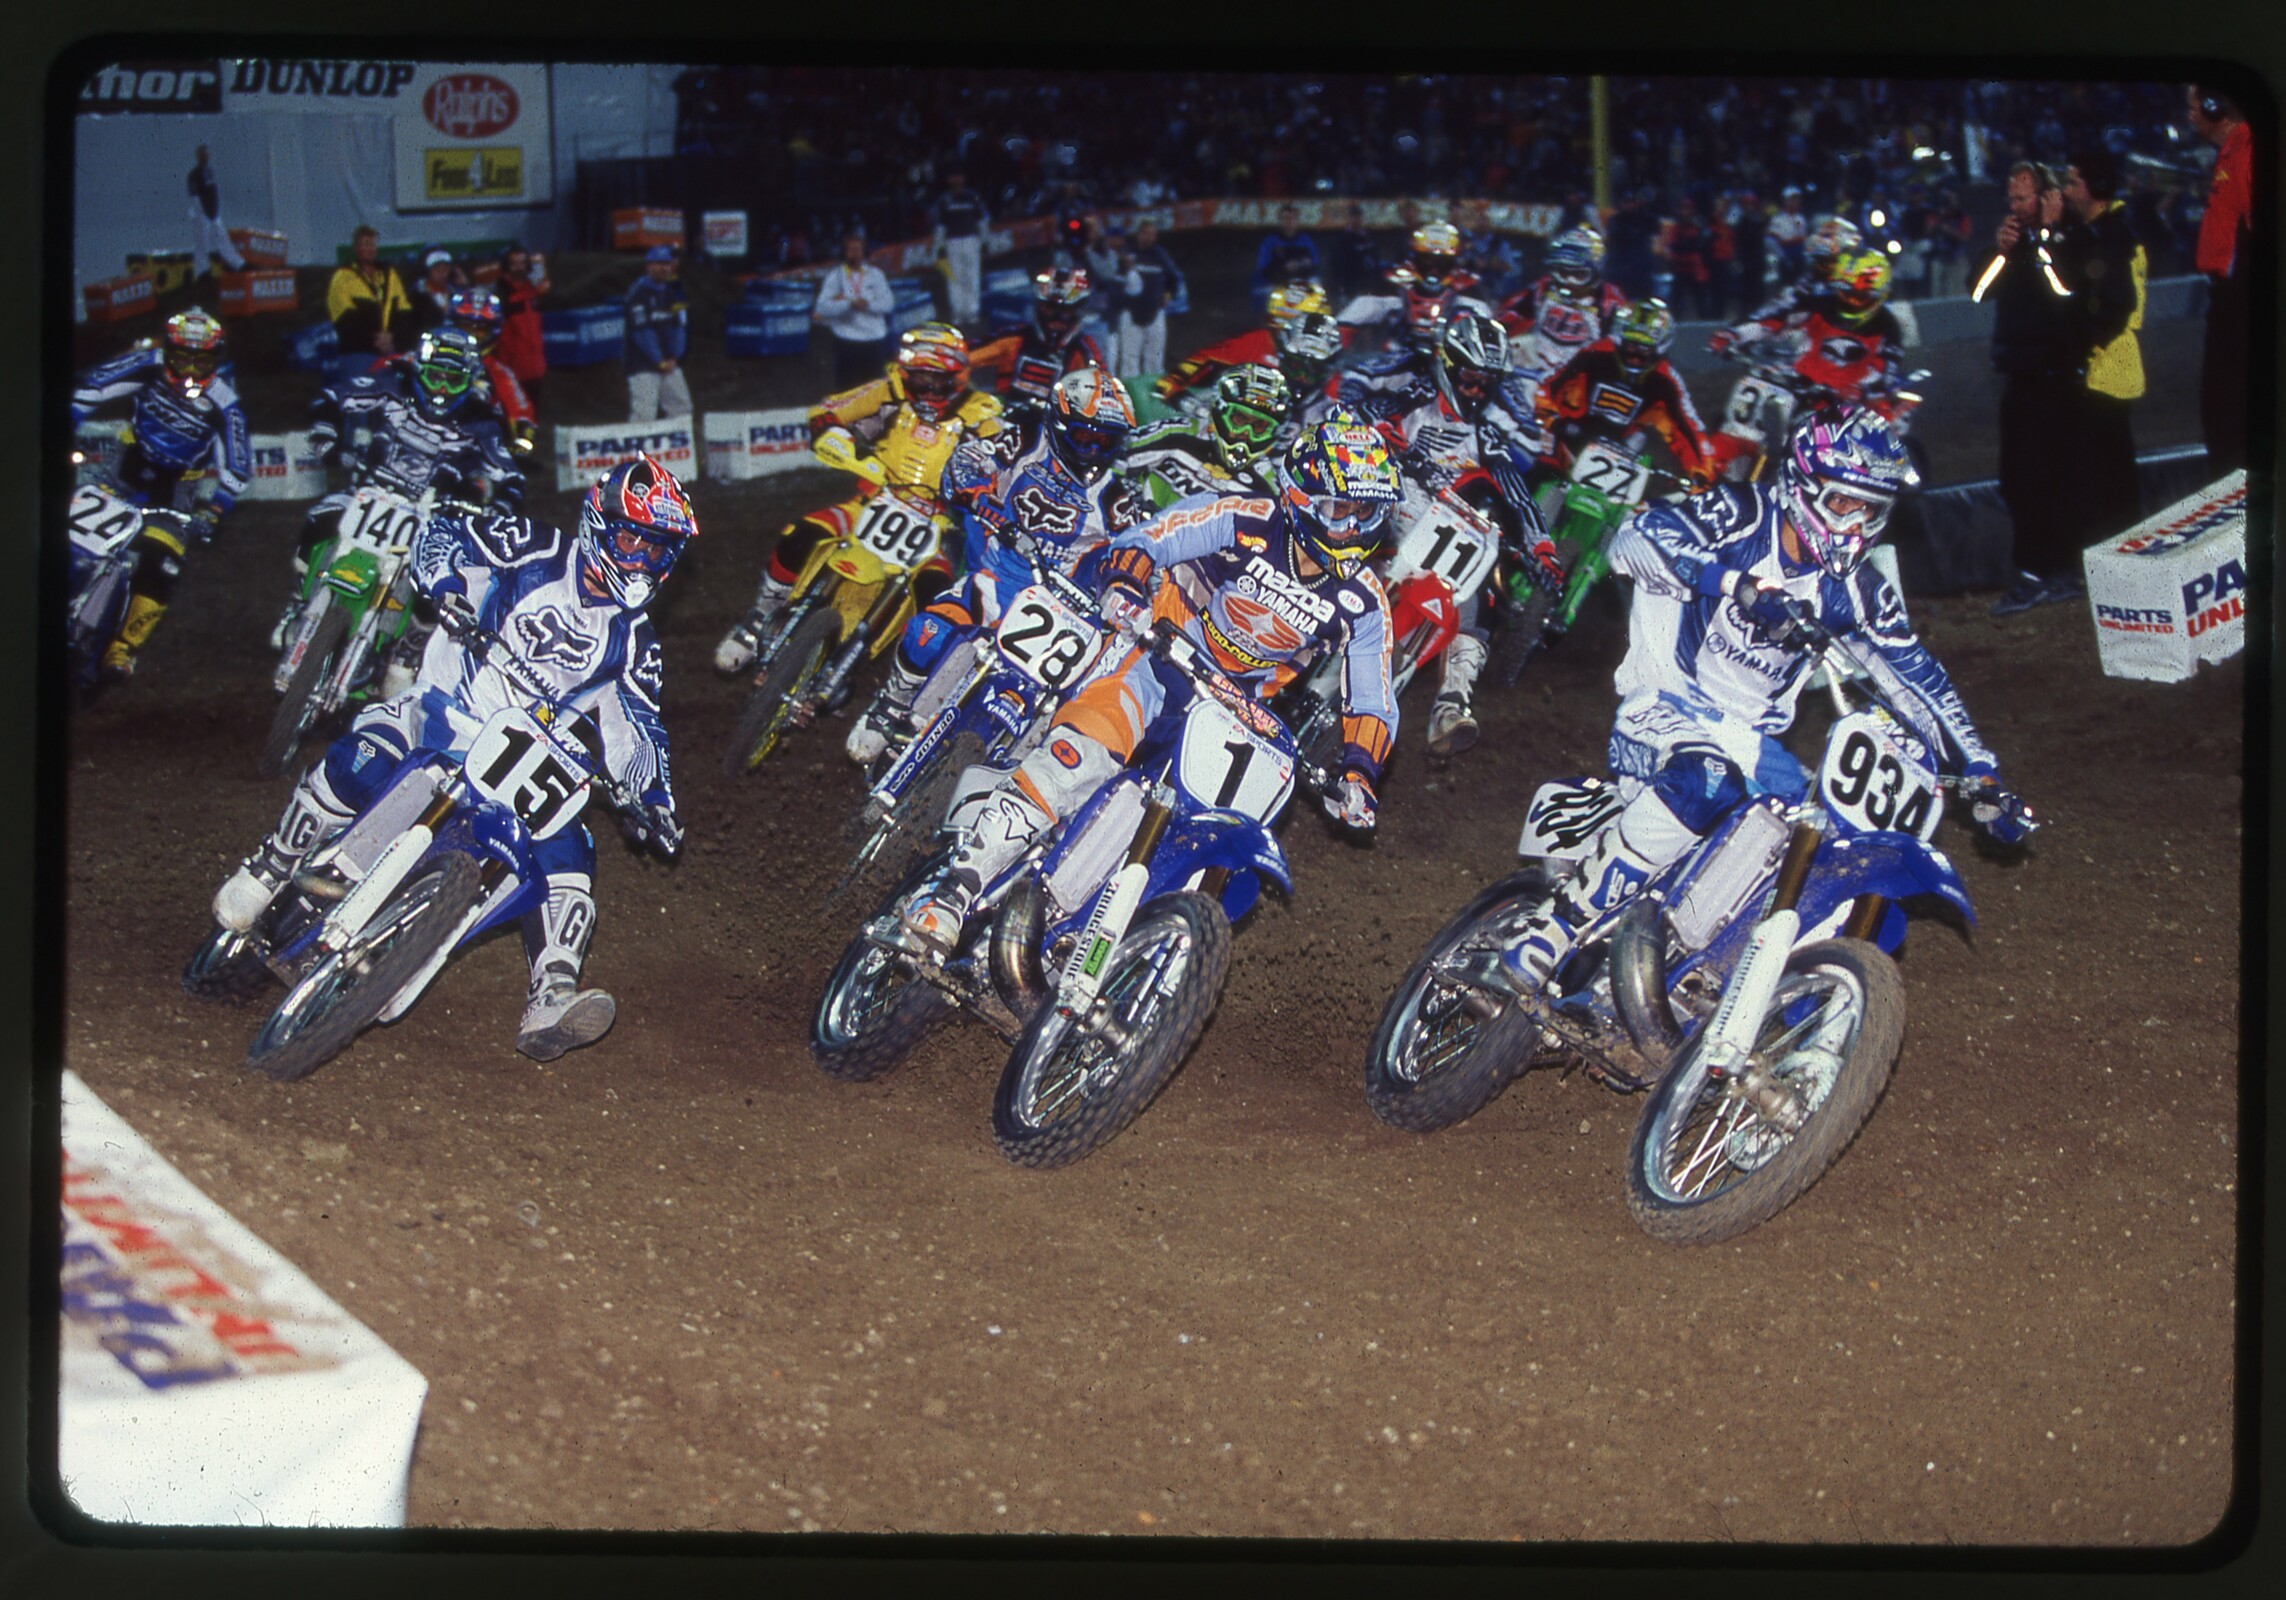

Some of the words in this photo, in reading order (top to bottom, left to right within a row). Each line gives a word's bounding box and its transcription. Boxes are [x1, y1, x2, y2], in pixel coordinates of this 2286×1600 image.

[229, 59, 417, 98] DUNLOP
[577, 431, 690, 457] PARTS
[750, 424, 809, 442] PART
[354, 499, 420, 550] 140
[857, 503, 935, 567] 199
[1420, 524, 1479, 581] 11
[1256, 586, 1320, 636] YAMAHA
[2096, 603, 2173, 624] PARTS
[2098, 618, 2175, 635] UNLIMITED
[1000, 603, 1087, 688] 28
[916, 711, 955, 763] DUNLOP
[986, 702, 1020, 737] YAMAHA
[549, 743, 581, 781] SPORTS
[1232, 724, 1246, 737] EA
[1247, 734, 1284, 768] SPORTS
[480, 724, 578, 835] 15
[1214, 740, 1256, 809] 1
[1830, 731, 1935, 835] 934
[488, 837, 520, 869] YAMAHA
[1067, 881, 1118, 981] BRIDGESTONE
